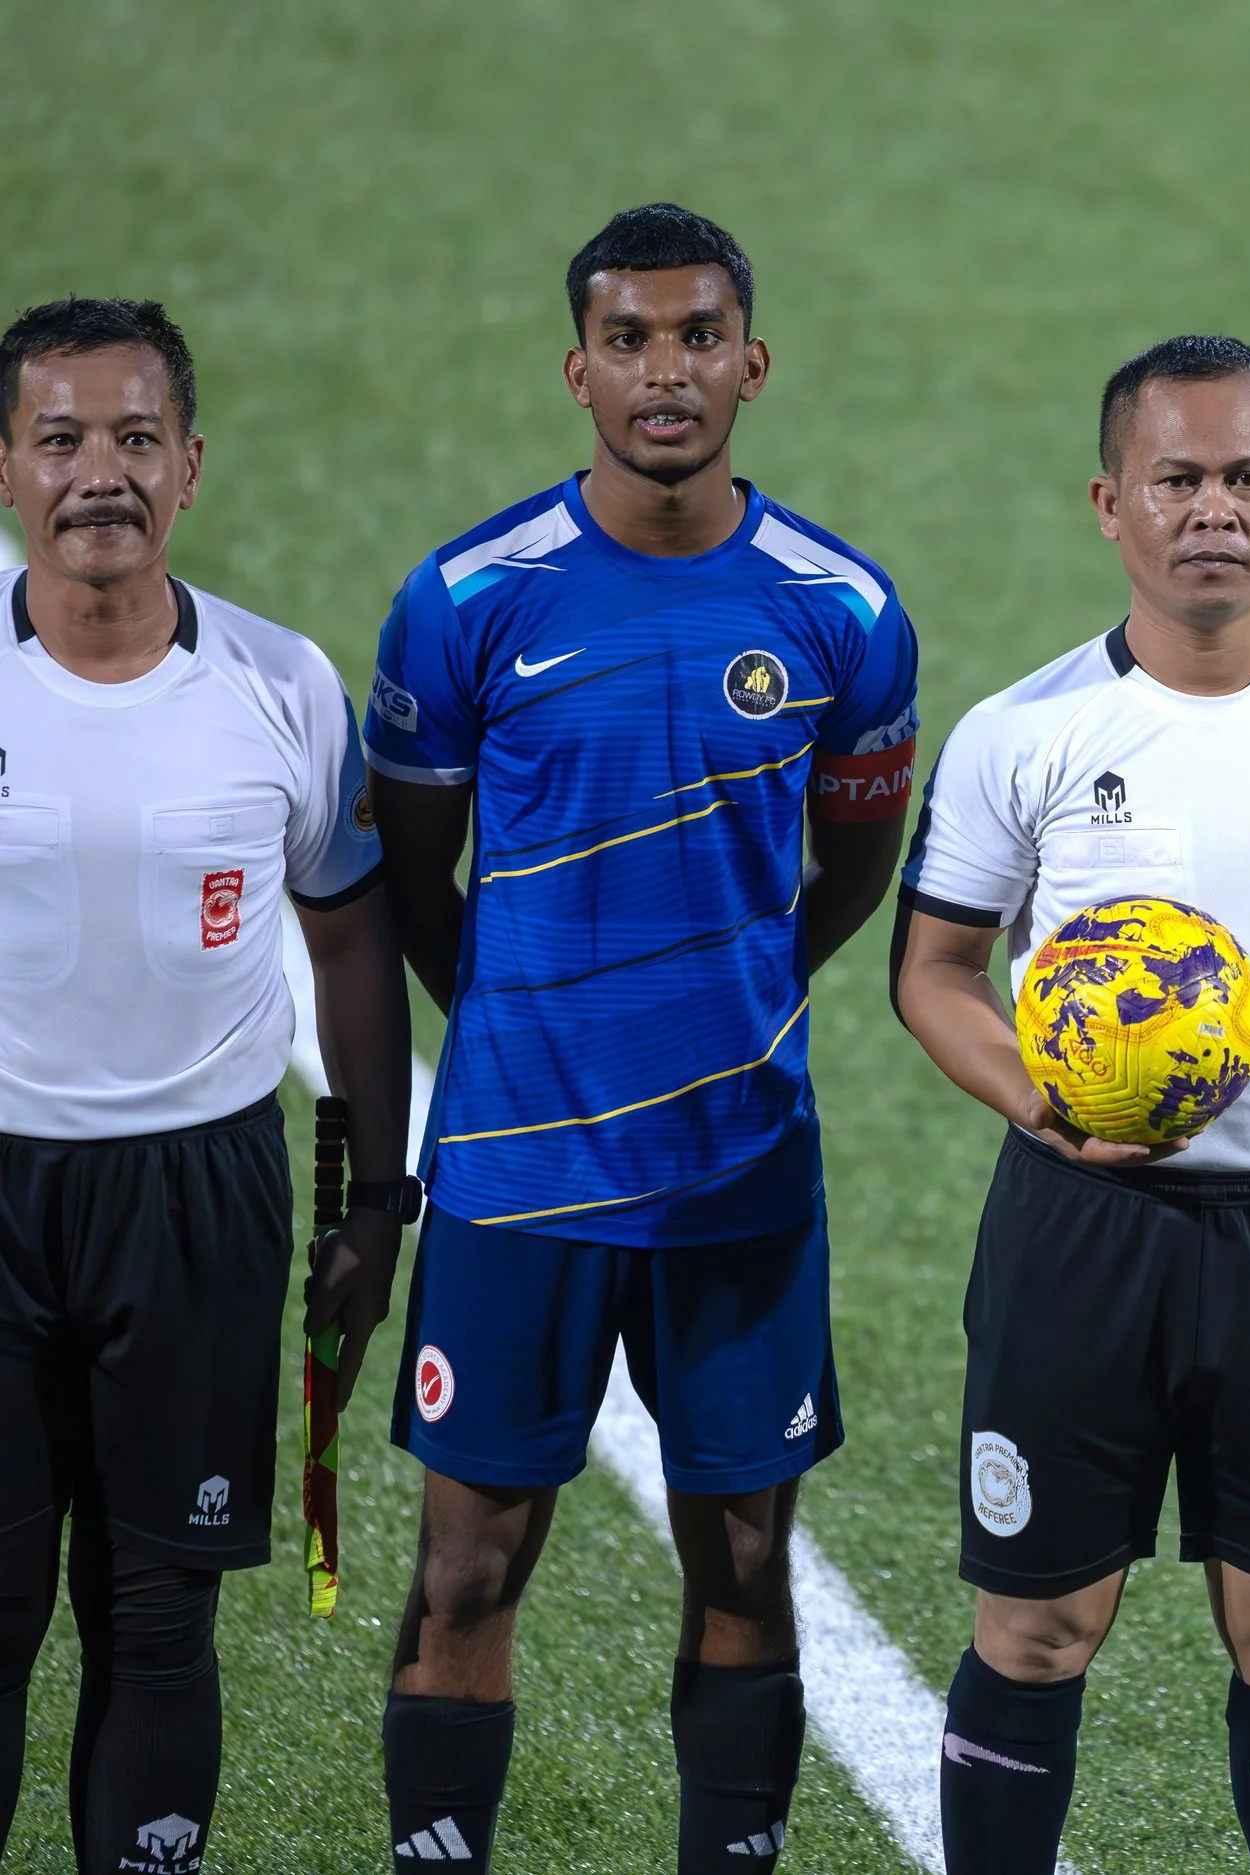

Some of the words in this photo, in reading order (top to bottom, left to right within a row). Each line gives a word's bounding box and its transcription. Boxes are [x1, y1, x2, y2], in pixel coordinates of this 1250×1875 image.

[764, 696, 777, 705] FC
[811, 757, 914, 801] PTAIN
[1090, 811, 1133, 825] MILLS
[784, 1413, 818, 1440] adidas
[188, 1512, 230, 1526] MILLS
[977, 1501, 1018, 1525] REFEREE
[118, 1856, 201, 1875] MILLS
